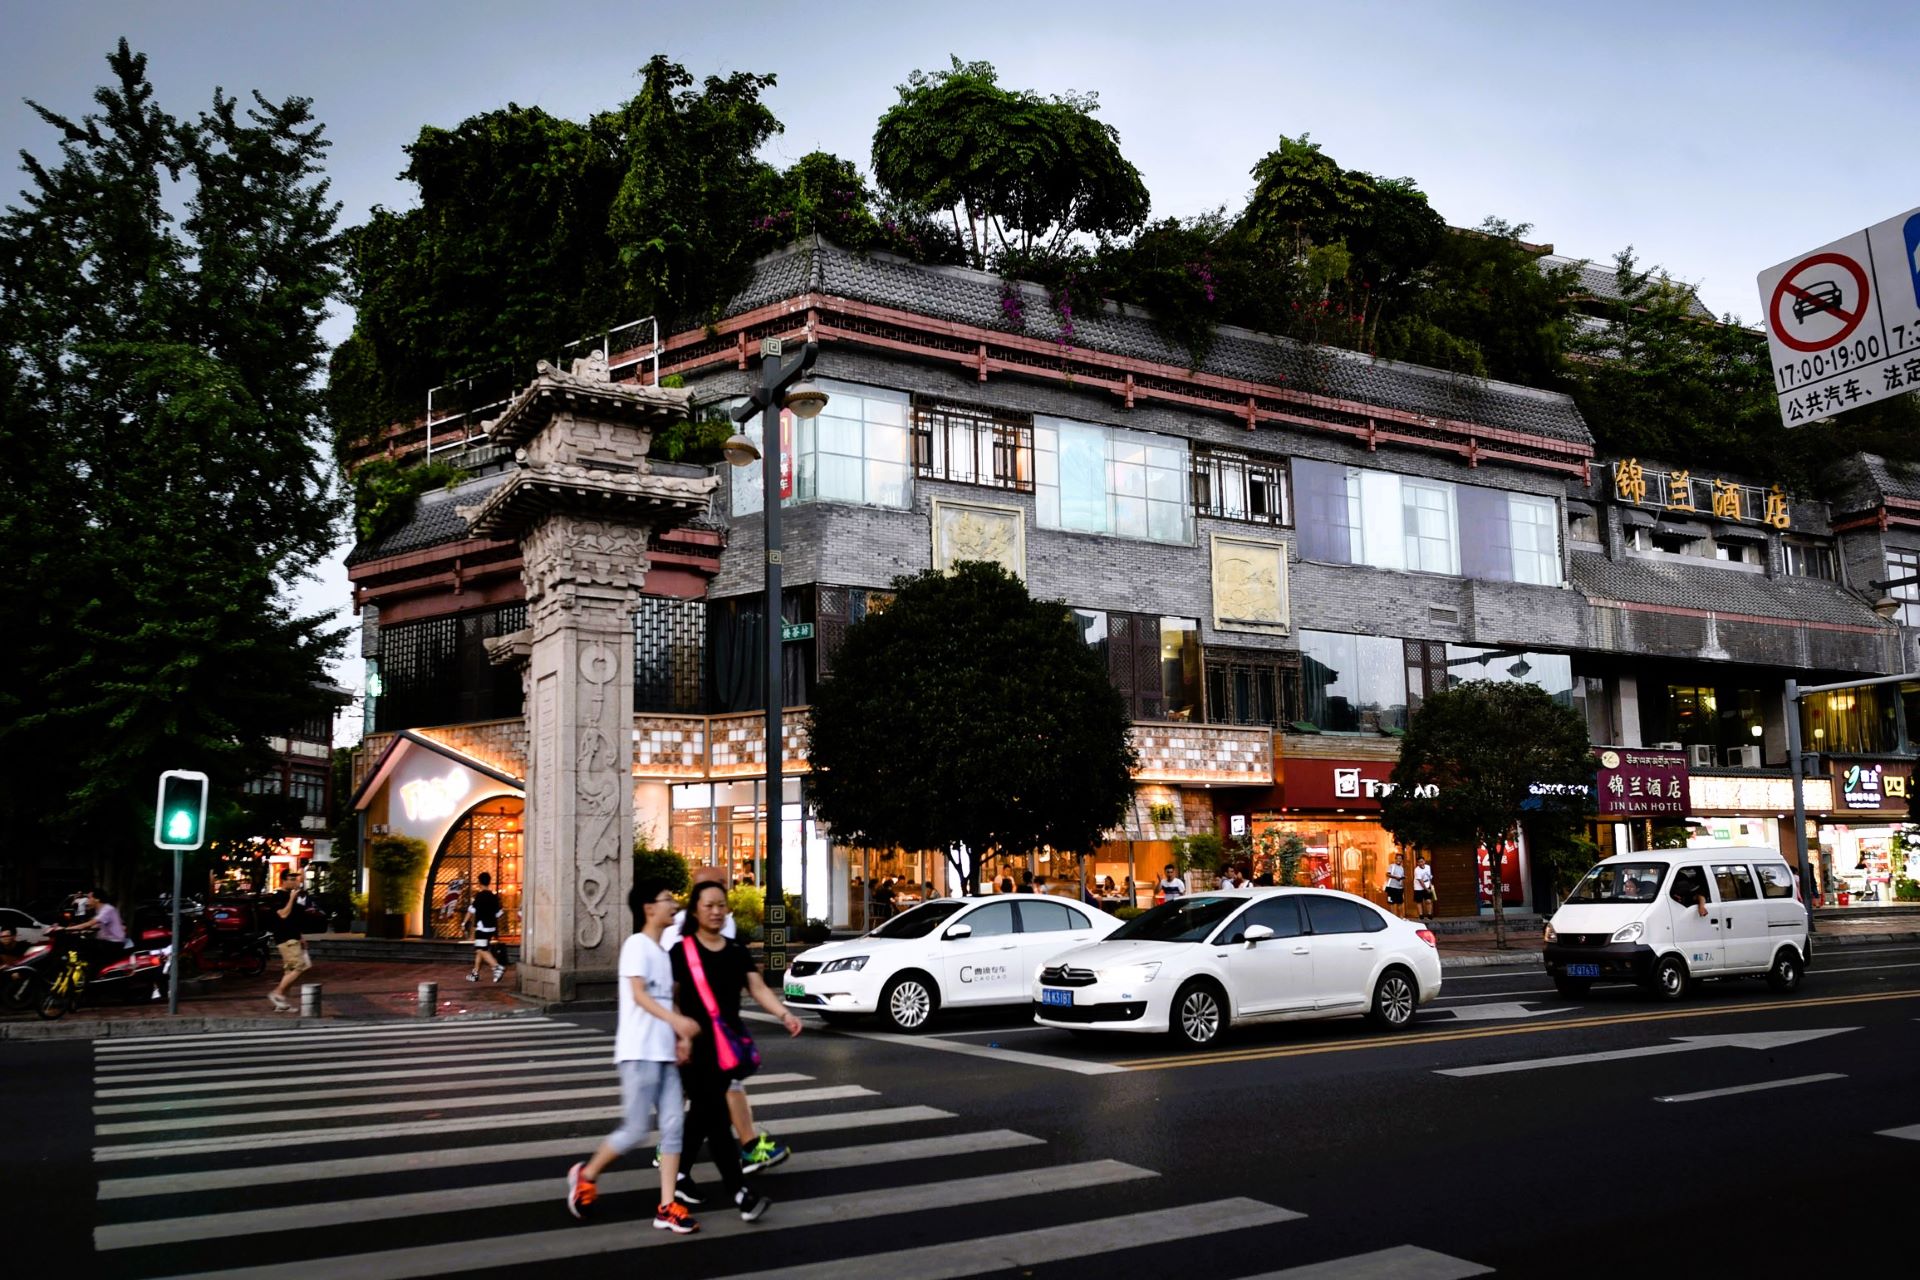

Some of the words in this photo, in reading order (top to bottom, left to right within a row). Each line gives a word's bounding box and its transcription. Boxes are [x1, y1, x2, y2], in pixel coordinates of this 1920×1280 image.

[1778, 335, 1880, 389] 17:00-19:00
[1616, 457, 1791, 529] 锦兰酒店
[1608, 774, 1681, 798] 锦兰酒店
[1610, 802, 1625, 811] JIN
[1629, 802, 1648, 811] LAN
[1651, 802, 1683, 811] HOTEL
